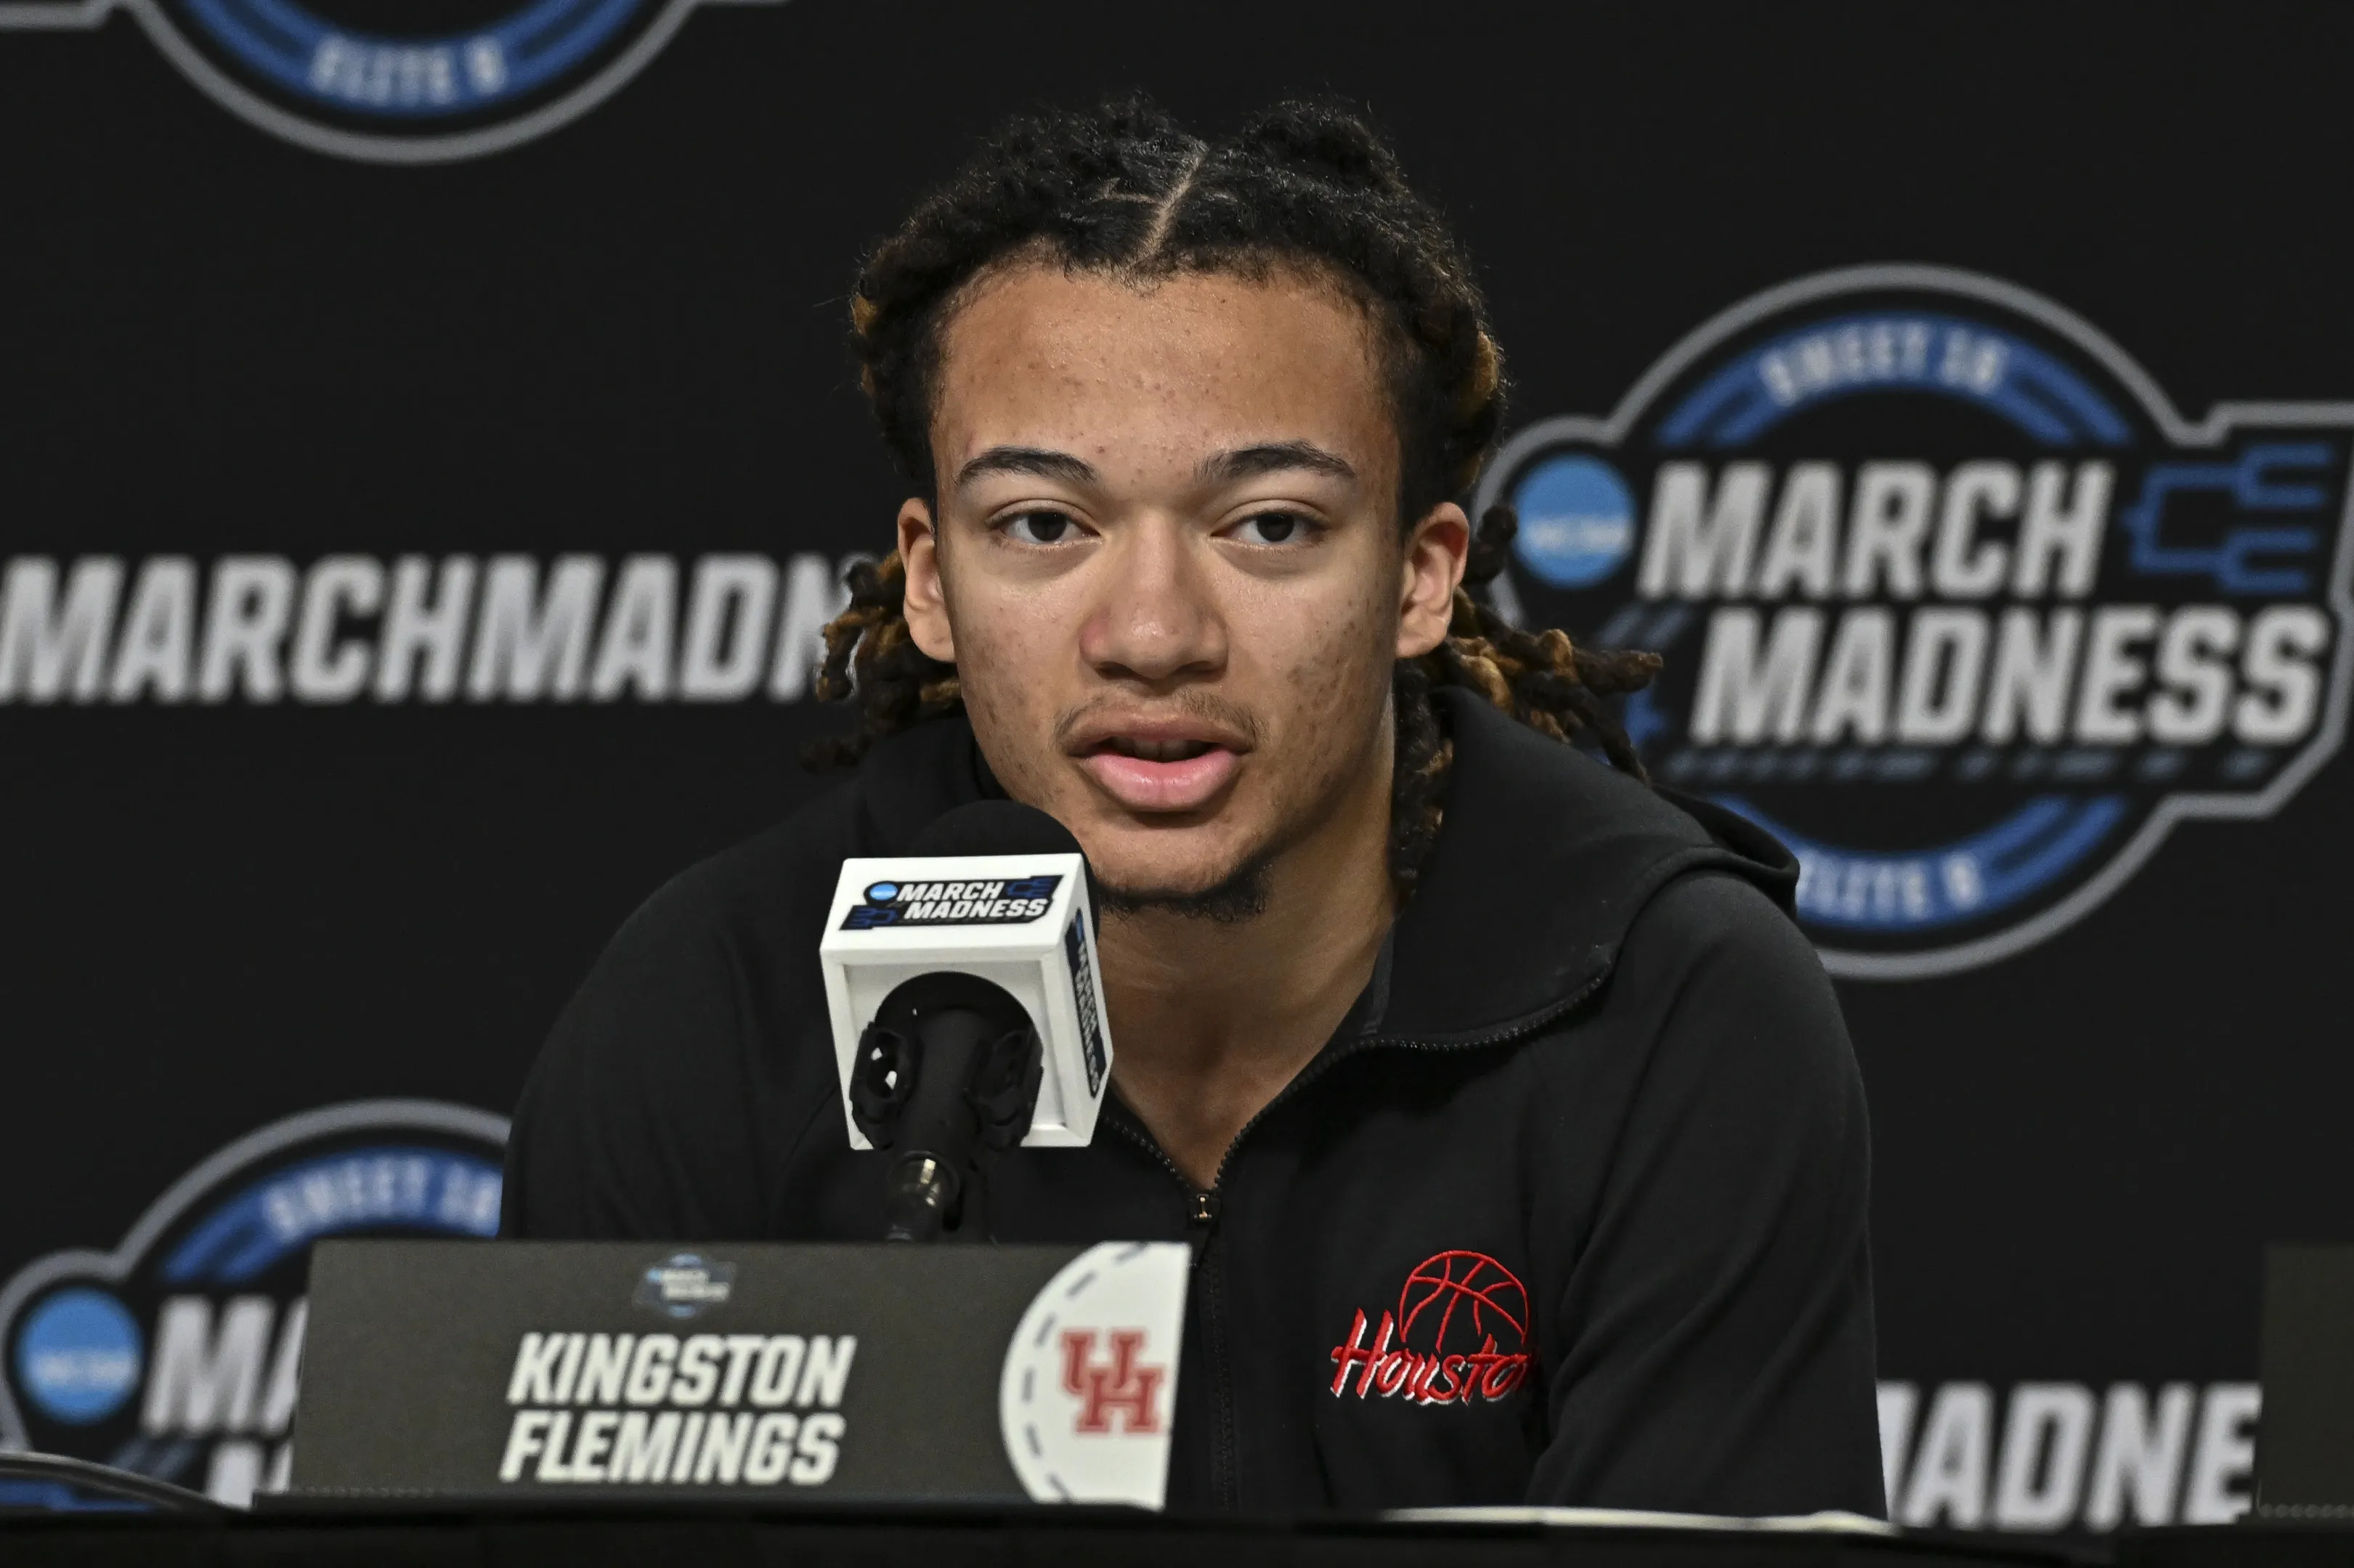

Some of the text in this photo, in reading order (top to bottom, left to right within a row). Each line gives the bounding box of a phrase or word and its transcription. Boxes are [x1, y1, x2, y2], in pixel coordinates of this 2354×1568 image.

[1639, 462, 2114, 600] MARCH
[1690, 604, 2330, 748] MADNESS
[896, 881, 1004, 902] MARCH
[904, 898, 1048, 920] MADNESS
[506, 1332, 858, 1407] KINGSTON
[1330, 1307, 1534, 1406] Housto
[499, 1410, 846, 1485] FLEMINGS
